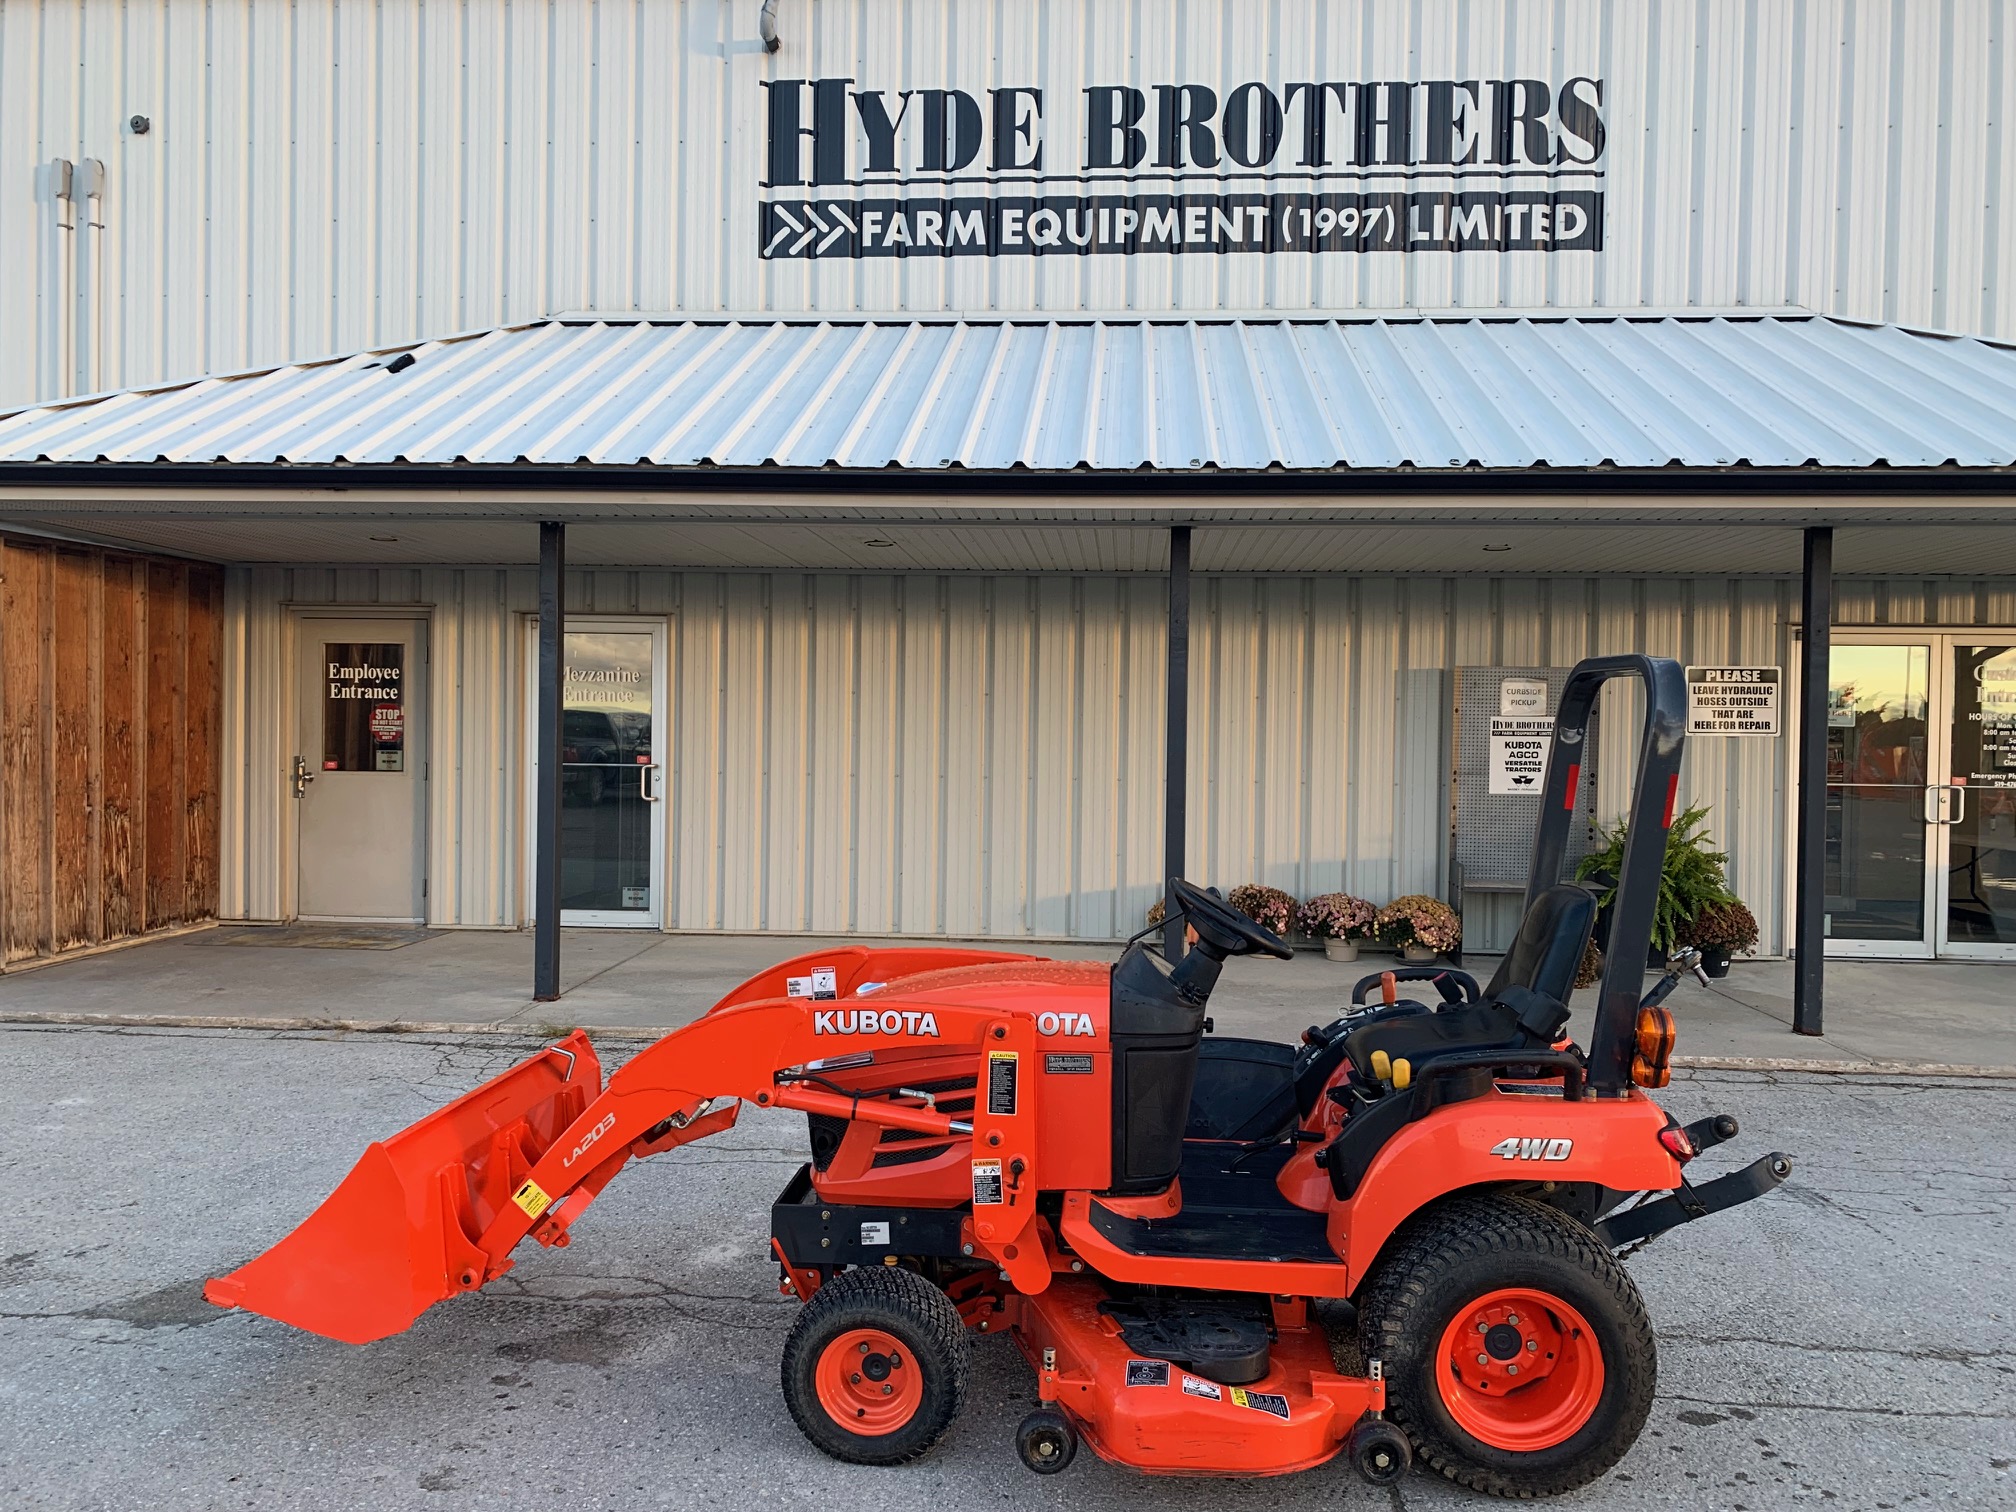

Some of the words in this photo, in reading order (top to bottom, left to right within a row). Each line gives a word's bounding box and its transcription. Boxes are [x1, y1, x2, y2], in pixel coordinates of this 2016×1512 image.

[759, 78, 1043, 187] HYDE
[1081, 76, 1606, 169] BROTHERS
[862, 209, 987, 248] FARM
[1002, 206, 1269, 247] EQUIPMENT
[1282, 204, 1395, 244] (1997)
[1410, 203, 1588, 243] LIMITED
[328, 662, 400, 683] Employee
[1705, 670, 1761, 682] PLEASE
[329, 683, 398, 700] Entrance
[563, 686, 633, 703] Entrance
[1692, 686, 1719, 695] LEAVE
[1721, 686, 1773, 695] HYDRAULIC
[1697, 697, 1727, 706] HOSES
[1729, 697, 1769, 706] OUTSIDE
[375, 709, 400, 720] STOP
[1711, 710, 1735, 718] THAT
[1736, 710, 1754, 718] ARE
[1968, 712, 1998, 721] HOURS
[1492, 720, 1514, 730] HYDE
[1694, 721, 1717, 729] HERE
[1719, 721, 1736, 729] FOR
[1738, 721, 1771, 730] REPAIR
[1504, 741, 1542, 749] KUBOTA
[1508, 751, 1539, 759] AGCO
[1971, 772, 2006, 780] Emergency
[813, 1009, 941, 1038] KUBOTA
[1035, 1011, 1097, 1038] OTA
[562, 1111, 617, 1168] LA203
[1490, 1137, 1574, 1161] 4WD
